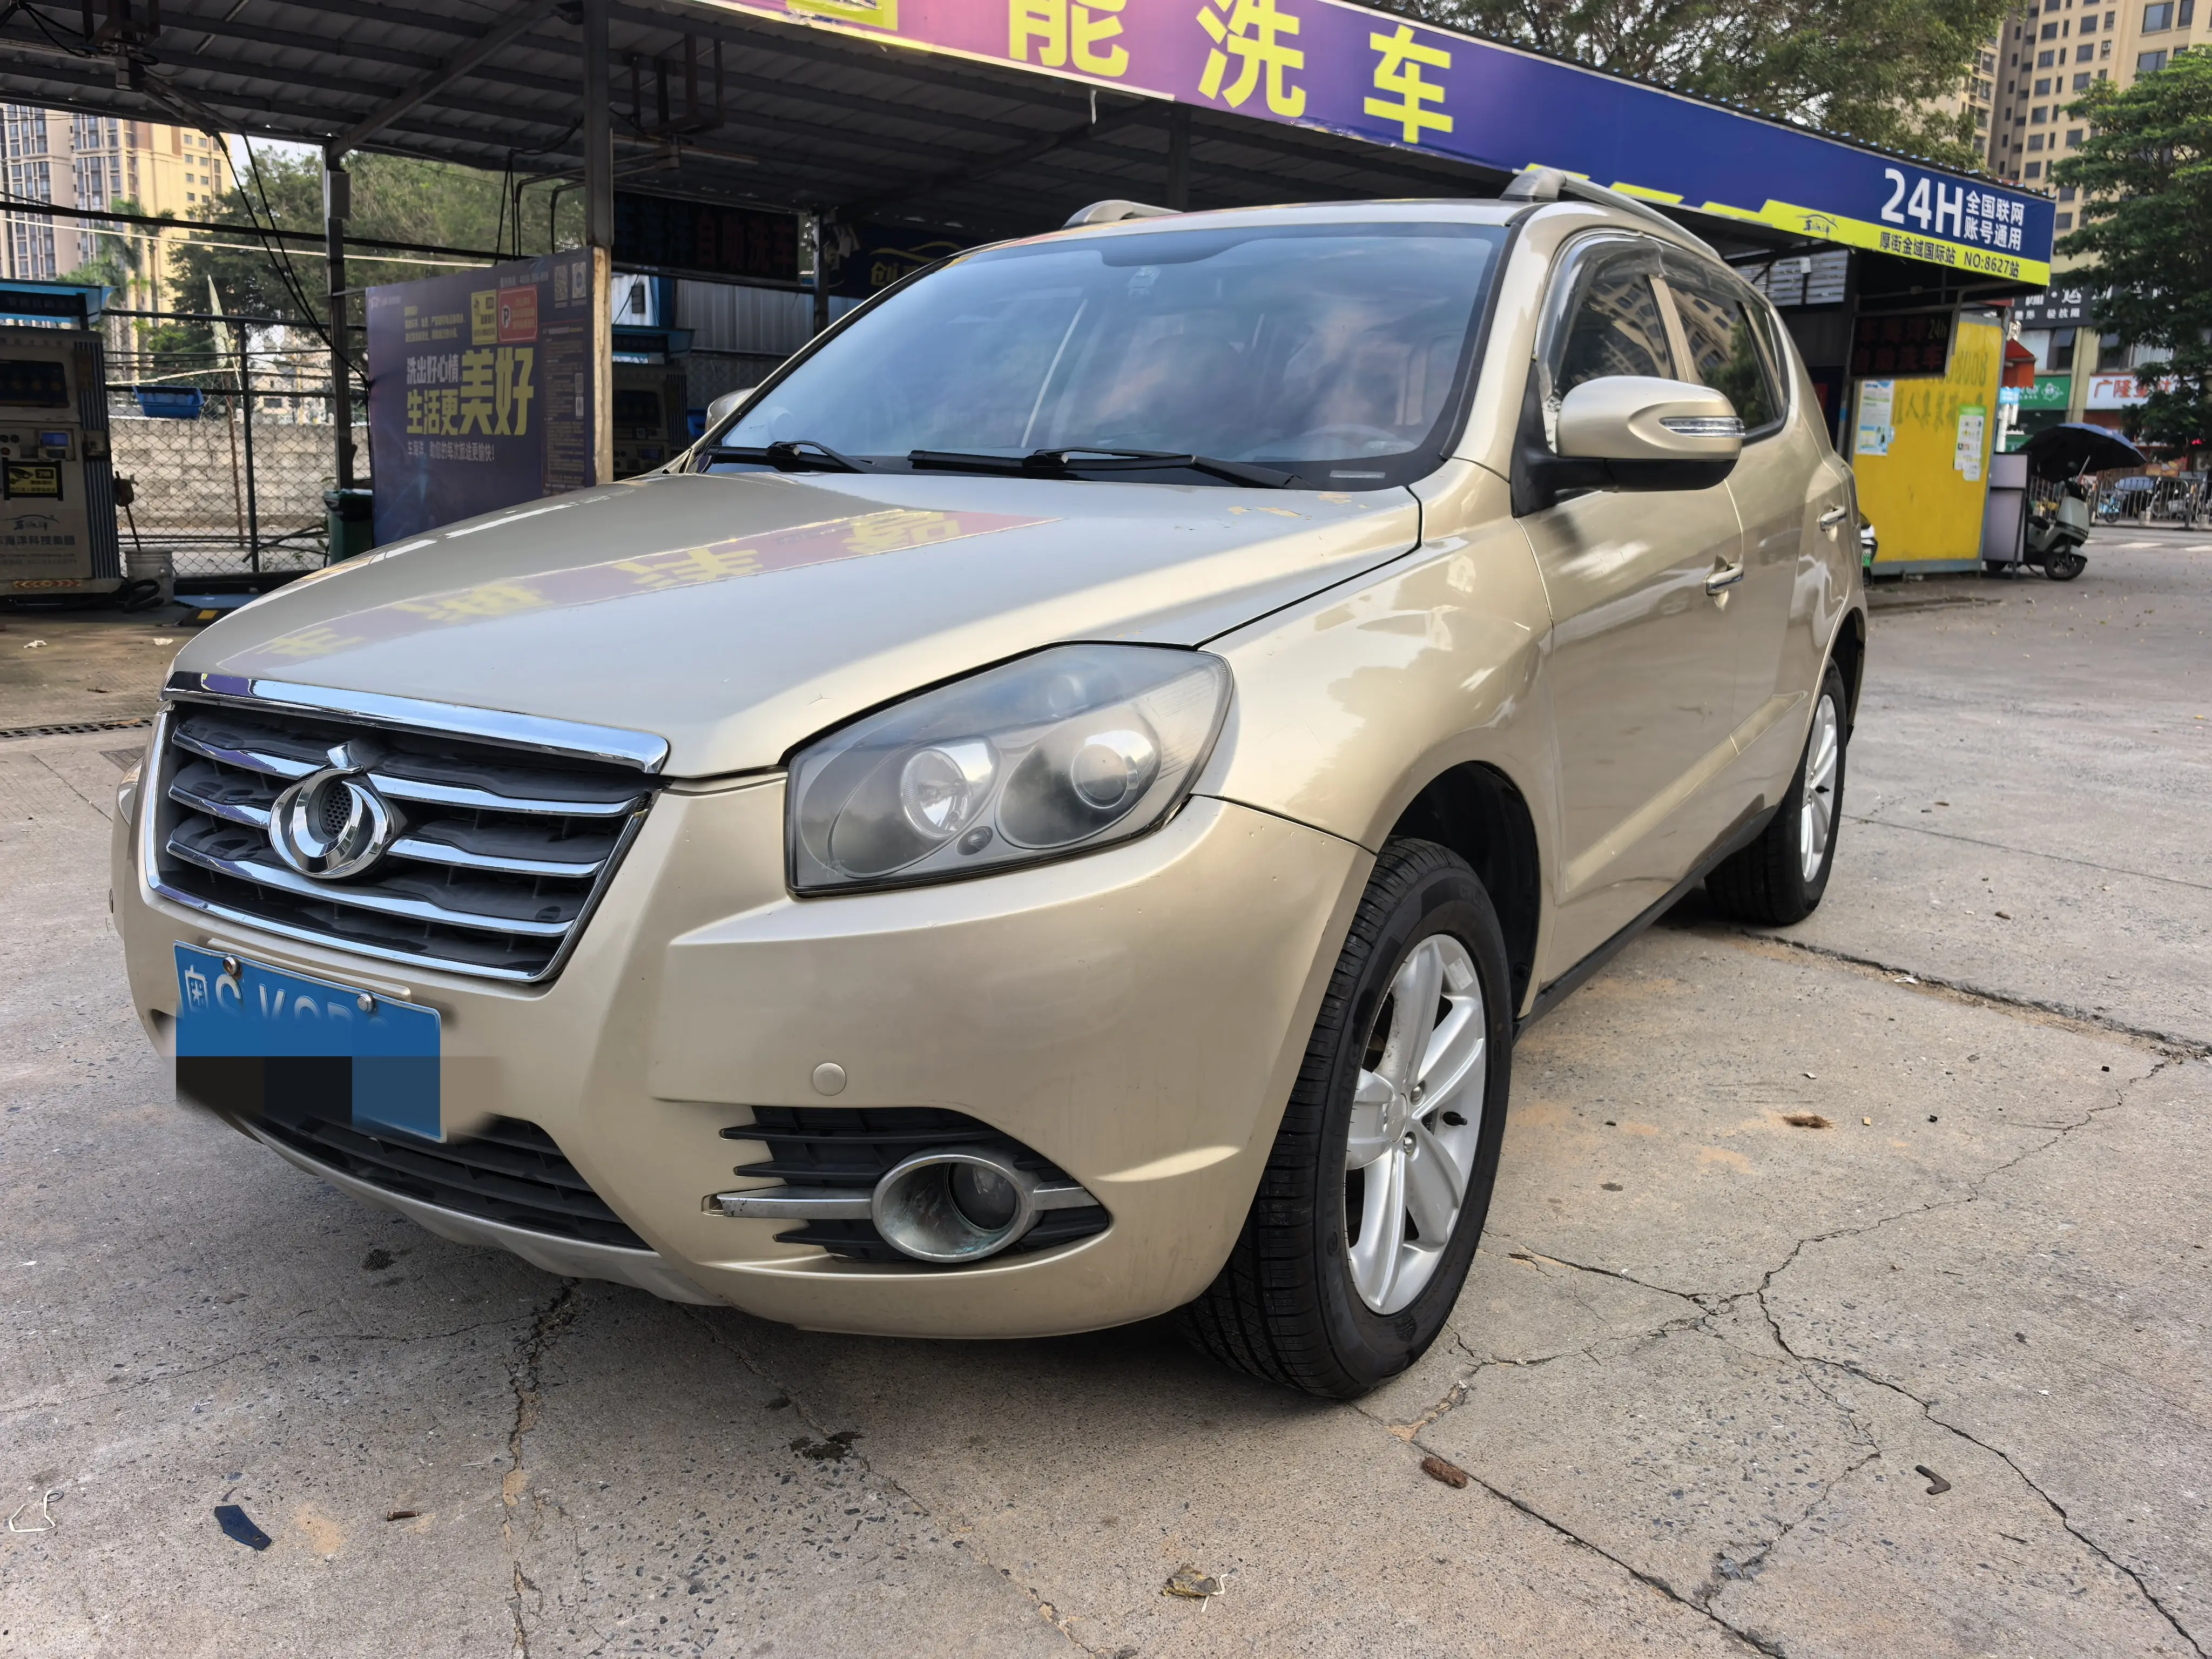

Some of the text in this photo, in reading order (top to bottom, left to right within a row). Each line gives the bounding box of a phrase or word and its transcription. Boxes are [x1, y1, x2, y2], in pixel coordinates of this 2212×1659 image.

[787, 0, 1453, 144] 能洗车
[1881, 168, 1964, 238] 24H
[1966, 190, 2024, 226] 全国联网
[1880, 231, 2020, 278] 厚街金域国际站 NO:8627站
[1964, 216, 2022, 252] 账号通用
